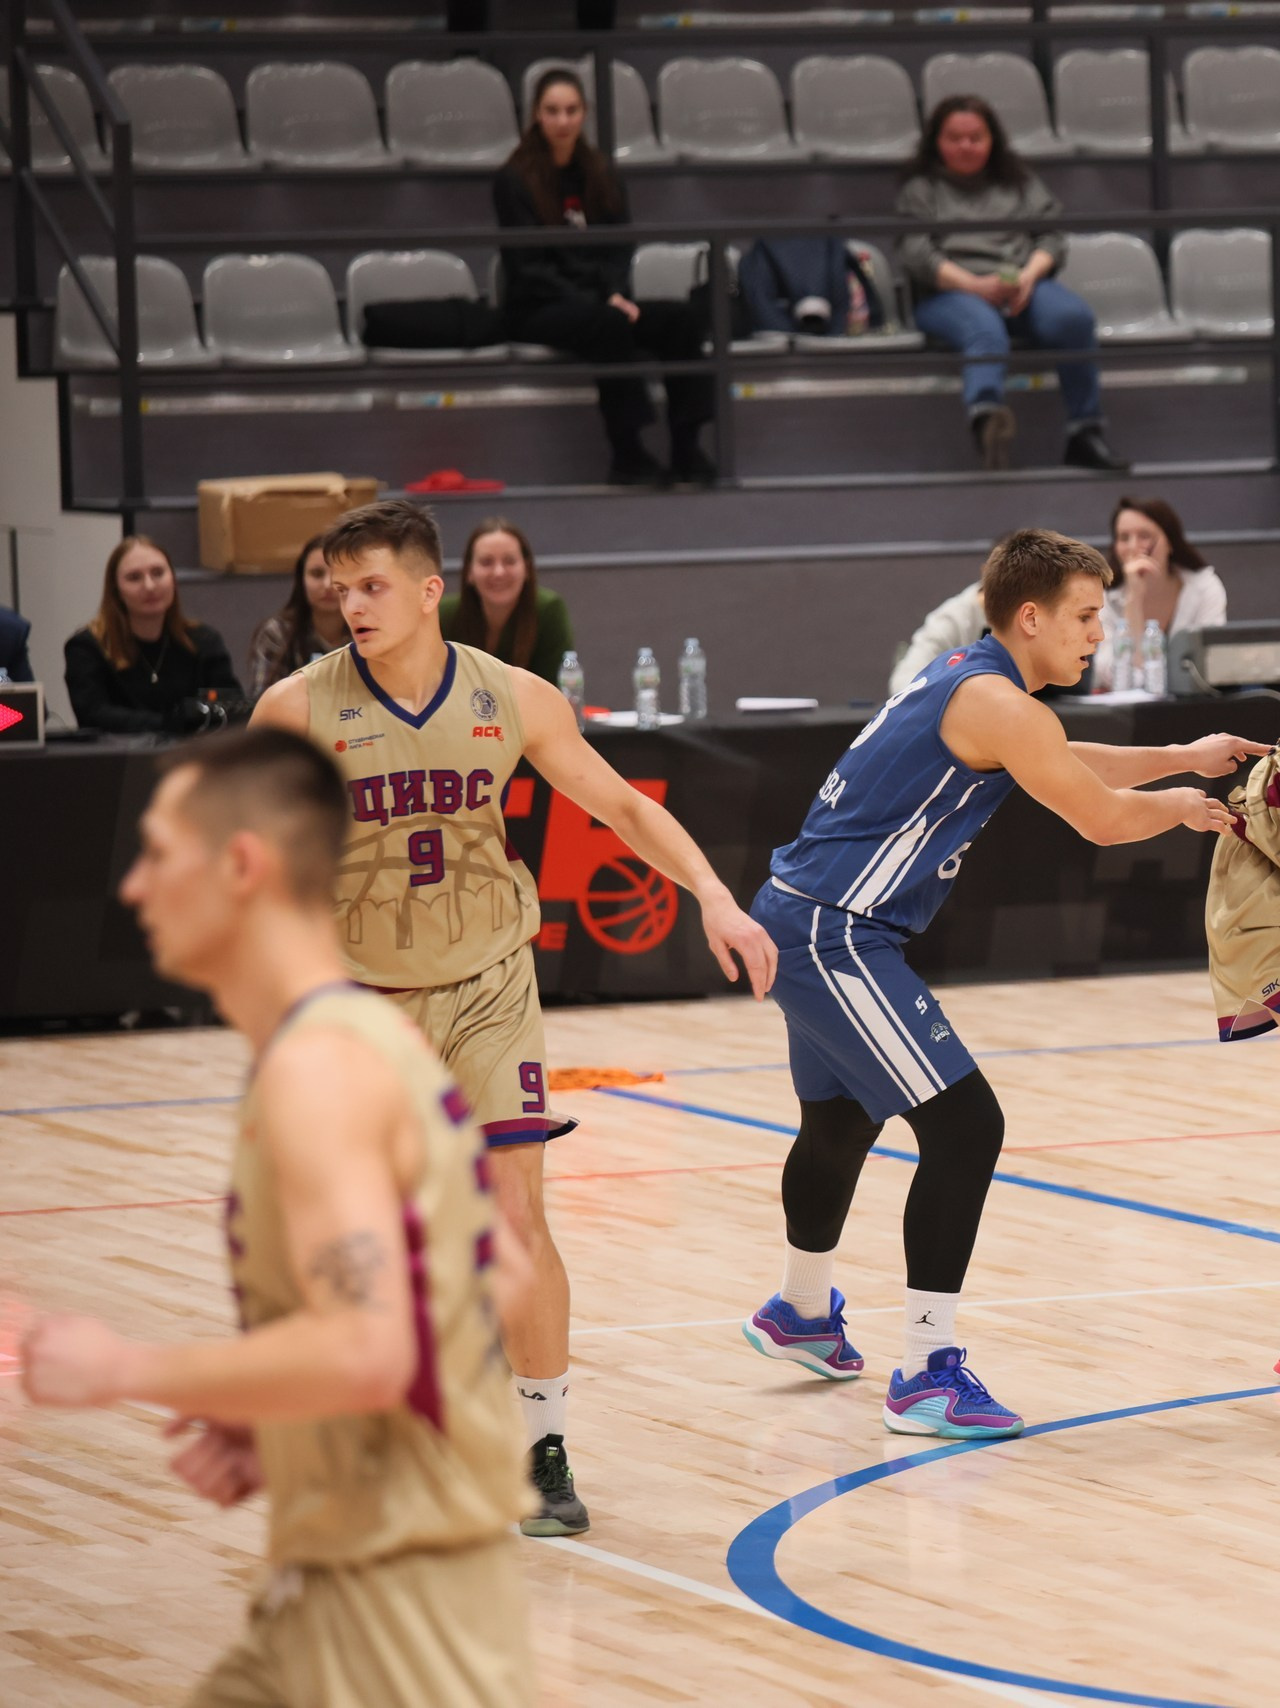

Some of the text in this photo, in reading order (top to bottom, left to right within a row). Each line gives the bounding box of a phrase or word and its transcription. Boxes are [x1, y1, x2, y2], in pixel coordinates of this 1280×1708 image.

[347, 768, 494, 826] ЦИВС
[407, 829, 445, 888] 9
[1261, 978, 1280, 998] STK
[518, 1061, 545, 1113] 9
